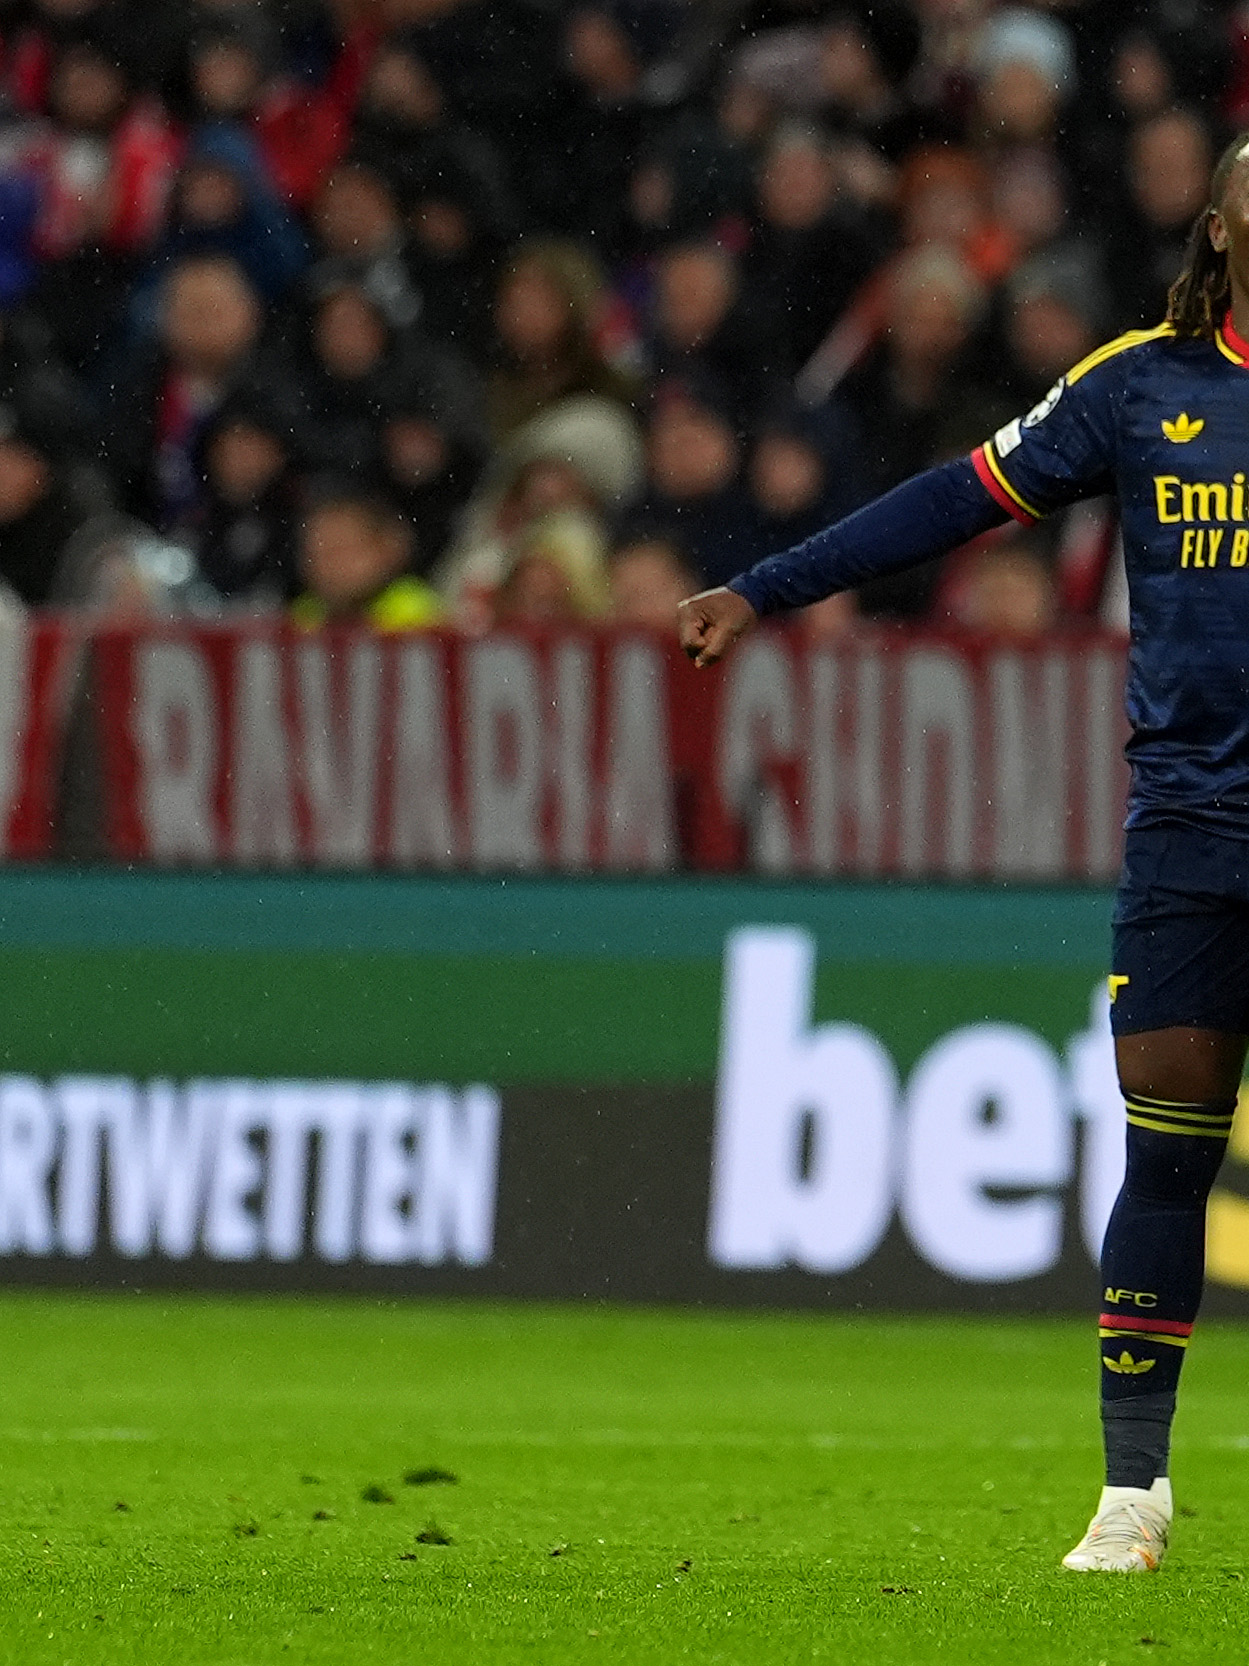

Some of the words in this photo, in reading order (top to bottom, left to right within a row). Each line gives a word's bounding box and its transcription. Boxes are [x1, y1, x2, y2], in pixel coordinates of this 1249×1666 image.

[1180, 528, 1224, 568] FLY
[0, 1072, 500, 1266] RTWETTEN
[1104, 1286, 1158, 1308] AFC
